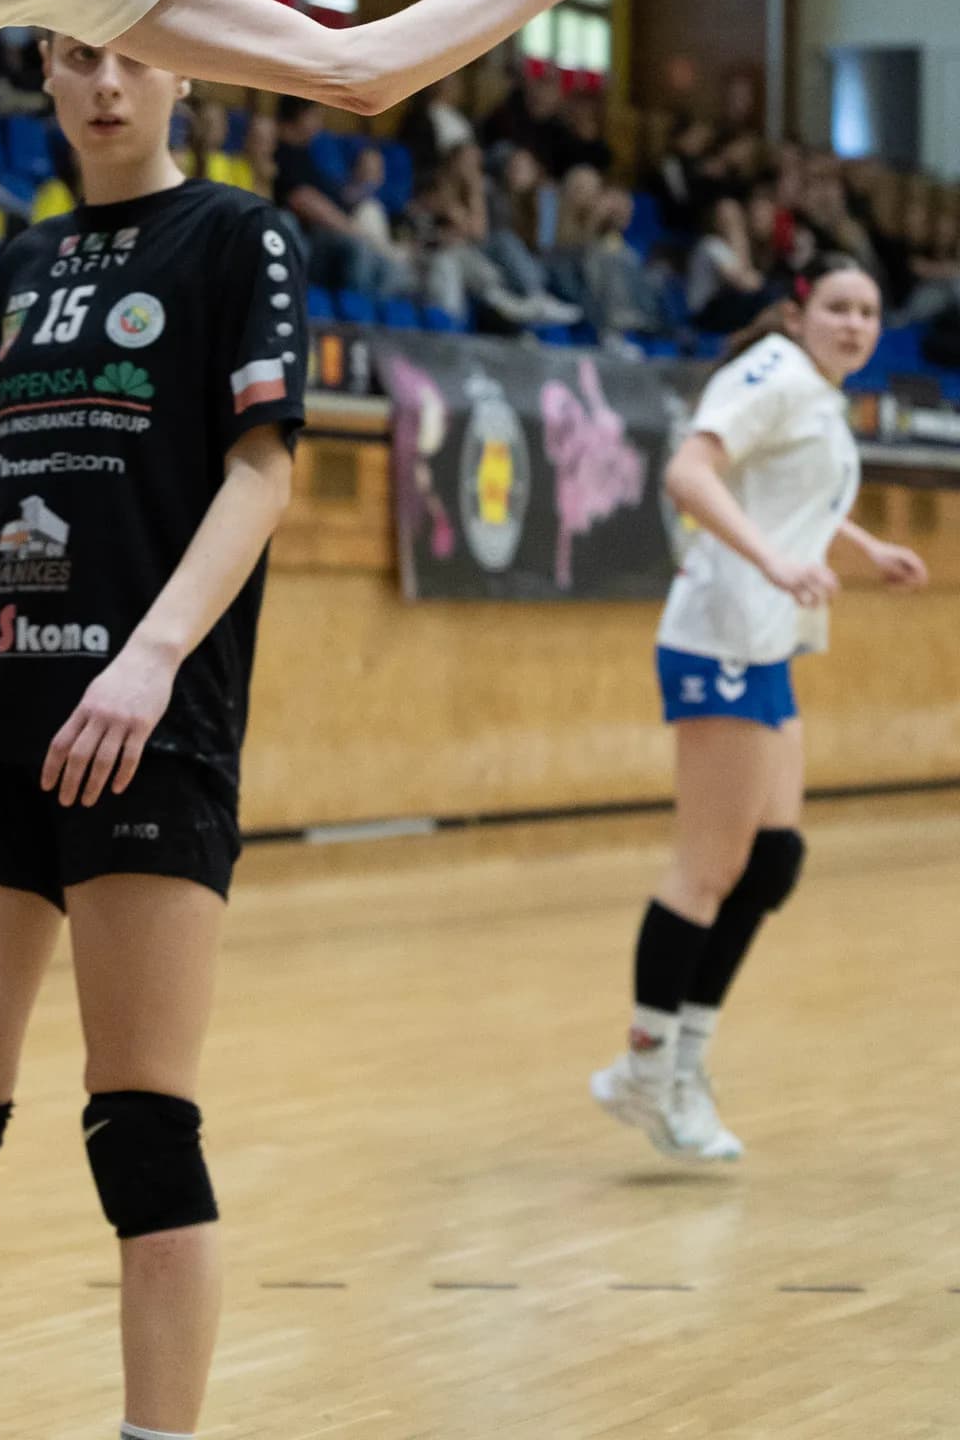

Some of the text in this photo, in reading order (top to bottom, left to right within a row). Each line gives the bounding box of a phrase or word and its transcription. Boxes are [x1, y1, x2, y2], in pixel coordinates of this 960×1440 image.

[31, 285, 97, 345] 15
[10, 410, 86, 435] INSURANCE
[88, 410, 152, 434] GROUP
